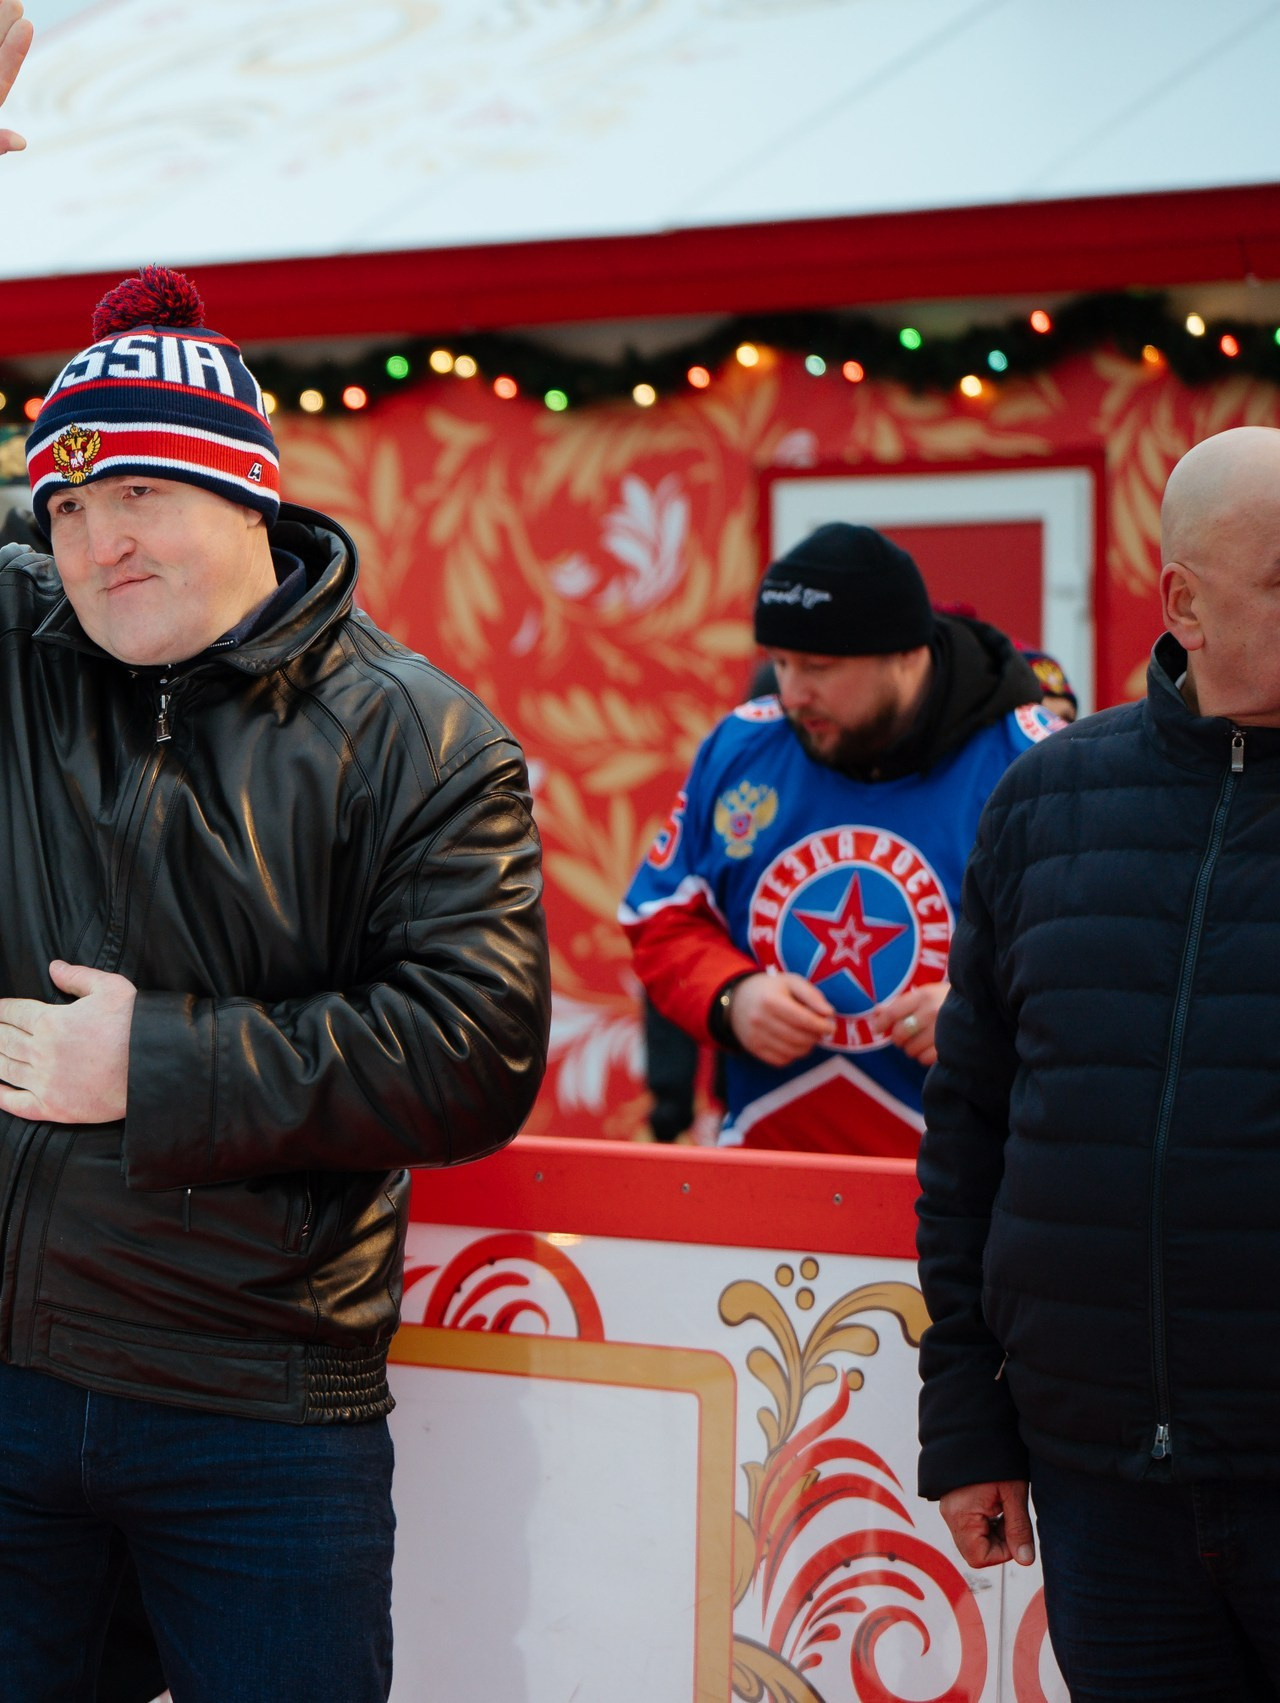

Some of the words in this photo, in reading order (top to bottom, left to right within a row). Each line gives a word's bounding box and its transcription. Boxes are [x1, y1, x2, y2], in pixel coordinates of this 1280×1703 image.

[41, 334, 235, 408] SSIA
[750, 830, 855, 945] ЗВЕЗДА
[869, 833, 949, 970] РОССИИ
